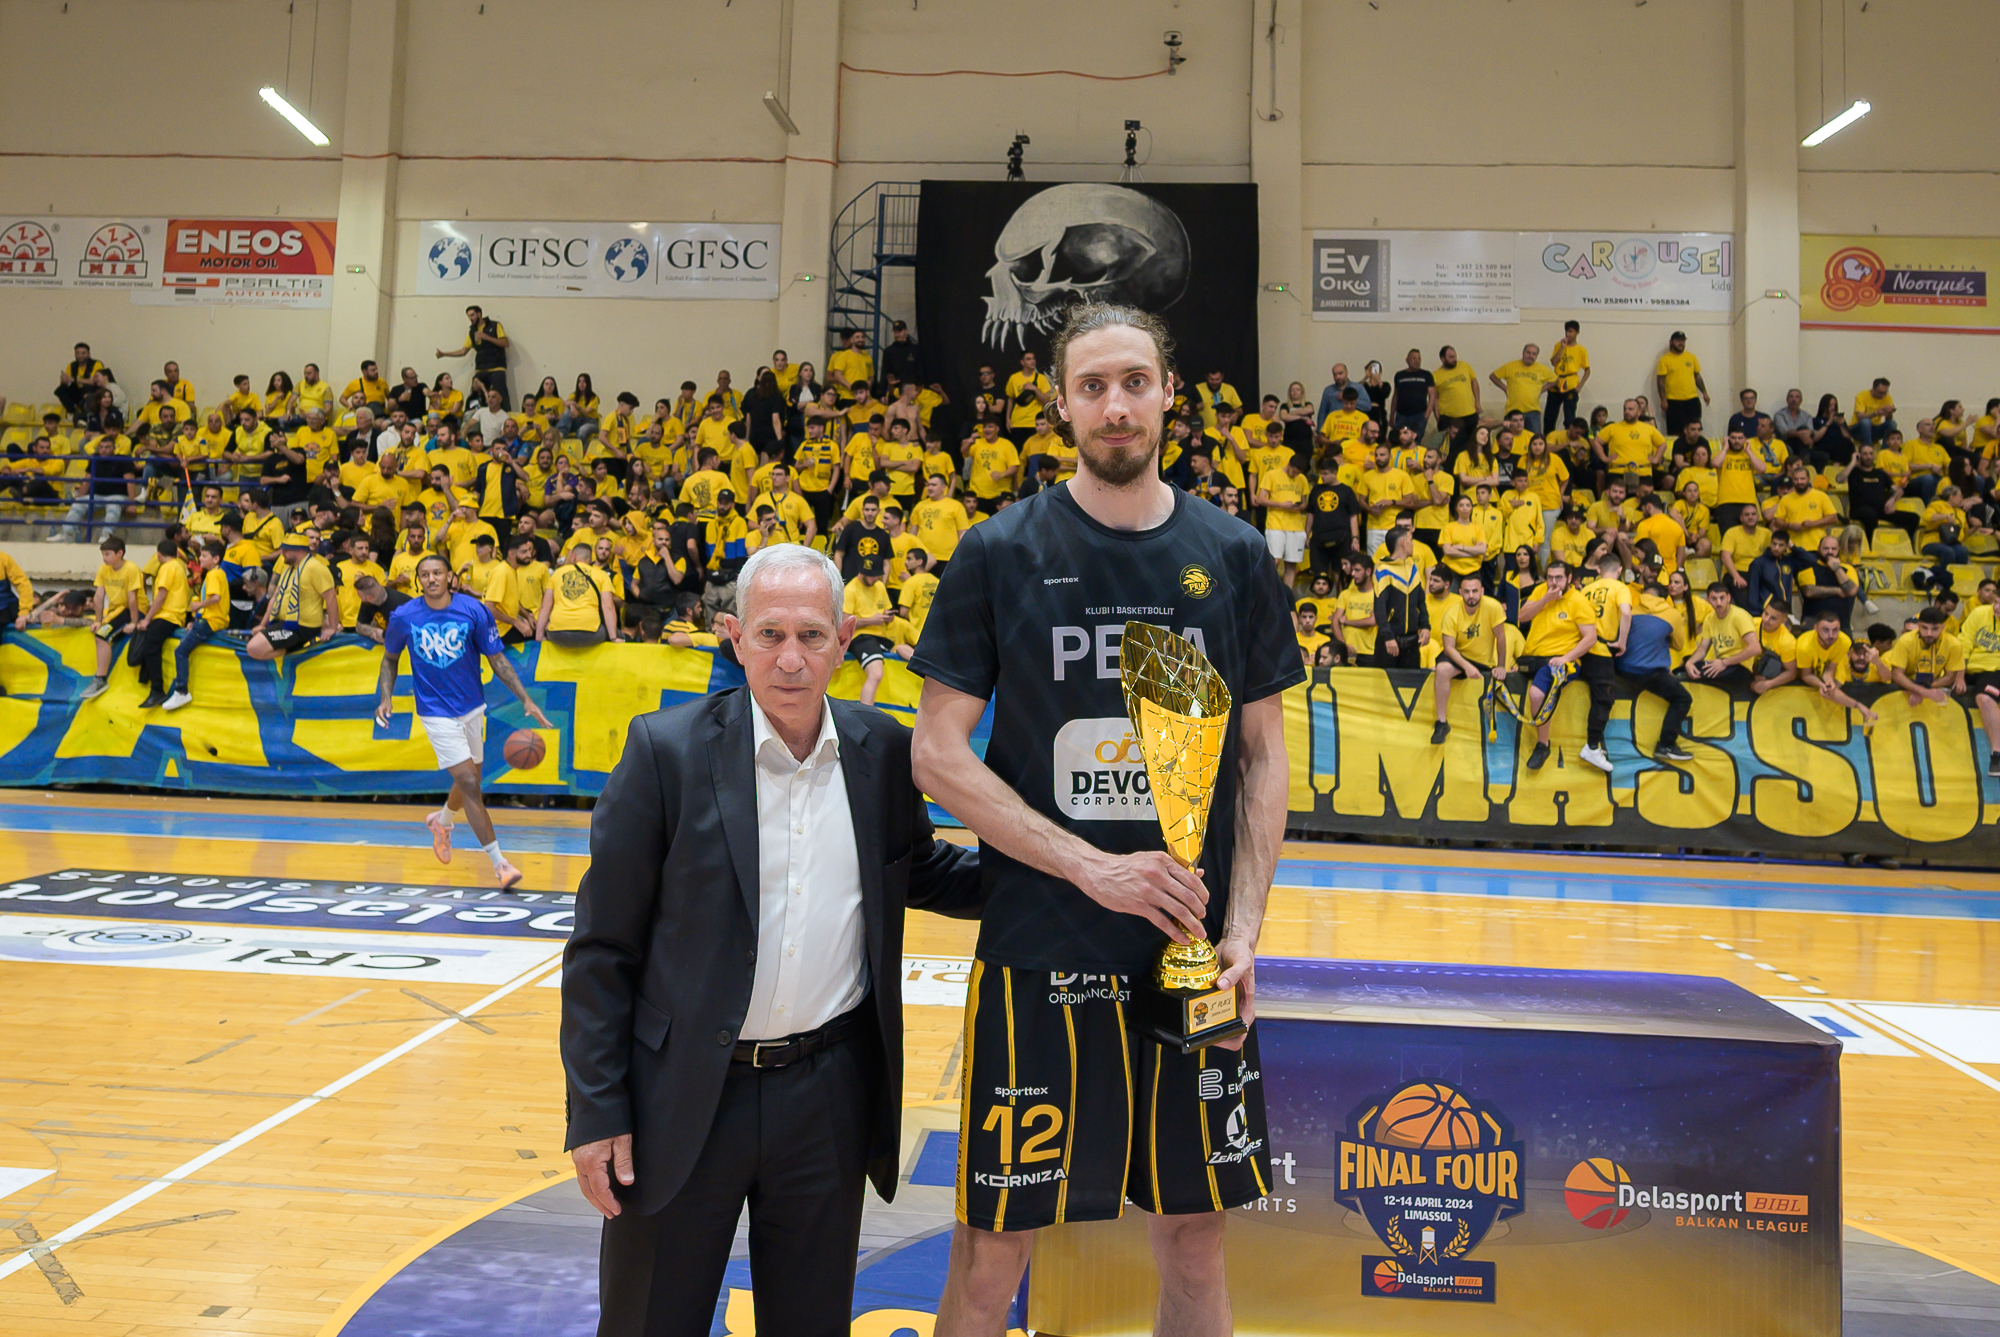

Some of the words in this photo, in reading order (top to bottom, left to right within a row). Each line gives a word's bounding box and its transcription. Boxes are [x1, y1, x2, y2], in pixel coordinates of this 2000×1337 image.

[0, 226, 50, 257] PIZZA
[88, 227, 141, 259] PIZZA
[176, 229, 303, 256] ENEOS
[489, 237, 589, 268] GFSC
[667, 239, 768, 270] GFSC
[0, 262, 46, 273] MIA
[89, 263, 136, 275] MIA
[200, 257, 251, 269] MOTOR
[255, 258, 278, 269] OIL
[225, 277, 322, 289] PSALTIS
[225, 289, 265, 297] AUTO
[271, 290, 322, 298] PARTS
[1043, 576, 1079, 586] sporttex
[1085, 606, 1110, 615] KLUBI
[1111, 606, 1115, 615] I
[1116, 606, 1175, 616] BASKETBOLLIT
[1070, 770, 1151, 795] DEVO
[1071, 797, 1152, 806] CORPORA
[994, 1086, 1049, 1098] sporttex
[982, 1104, 1063, 1165] 12
[1340, 1140, 1427, 1191] FINAL
[1435, 1150, 1518, 1200] FOUR
[975, 1167, 1067, 1189] KORNIZA
[1383, 1195, 1412, 1206] 12-14
[1414, 1196, 1443, 1208] APRIL
[1445, 1198, 1473, 1210] 2024
[1618, 1184, 1743, 1216] Delasport
[1753, 1196, 1802, 1213] BIBL
[1404, 1209, 1453, 1222] LIMASSOL
[1675, 1216, 1739, 1229] BALKAN
[1746, 1219, 1809, 1233] LEAGUE
[1397, 1272, 1454, 1287] Delasport
